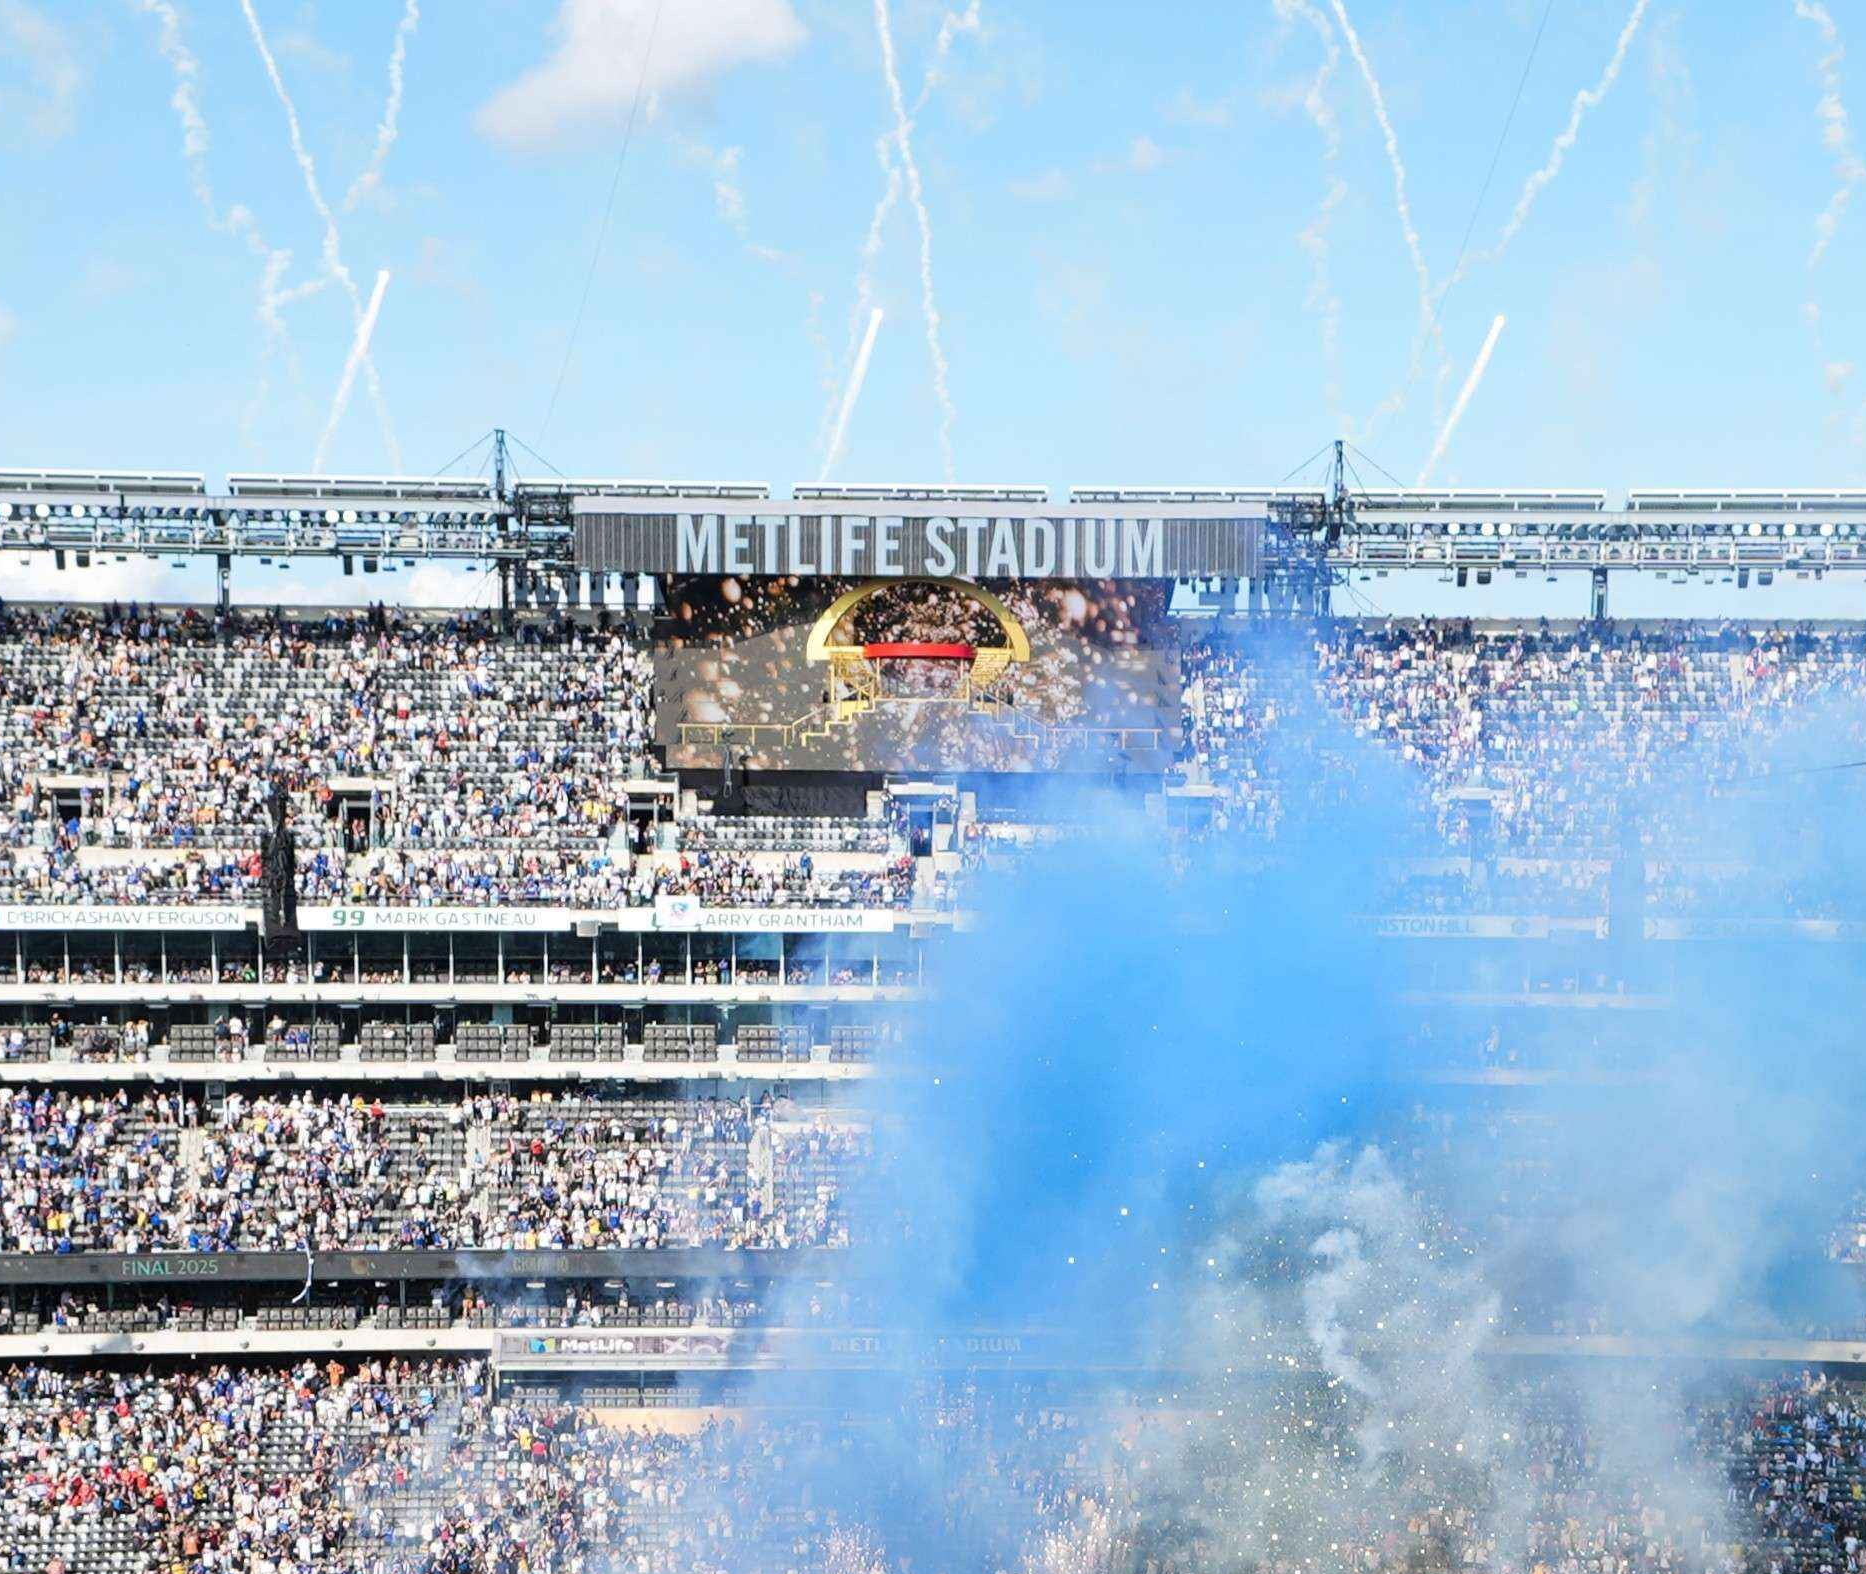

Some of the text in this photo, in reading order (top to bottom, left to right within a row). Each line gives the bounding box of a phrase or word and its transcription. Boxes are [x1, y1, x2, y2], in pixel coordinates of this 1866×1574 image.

[676, 514, 1164, 579] METLIFE STADIUM
[147, 911, 239, 925] FERGUSON
[333, 911, 536, 926] 99 MARK GASTINEAU
[705, 913, 863, 927] ARRY GRANTHAM
[121, 1259, 219, 1275] FINAL 2025
[561, 1338, 634, 1353] MetLife
